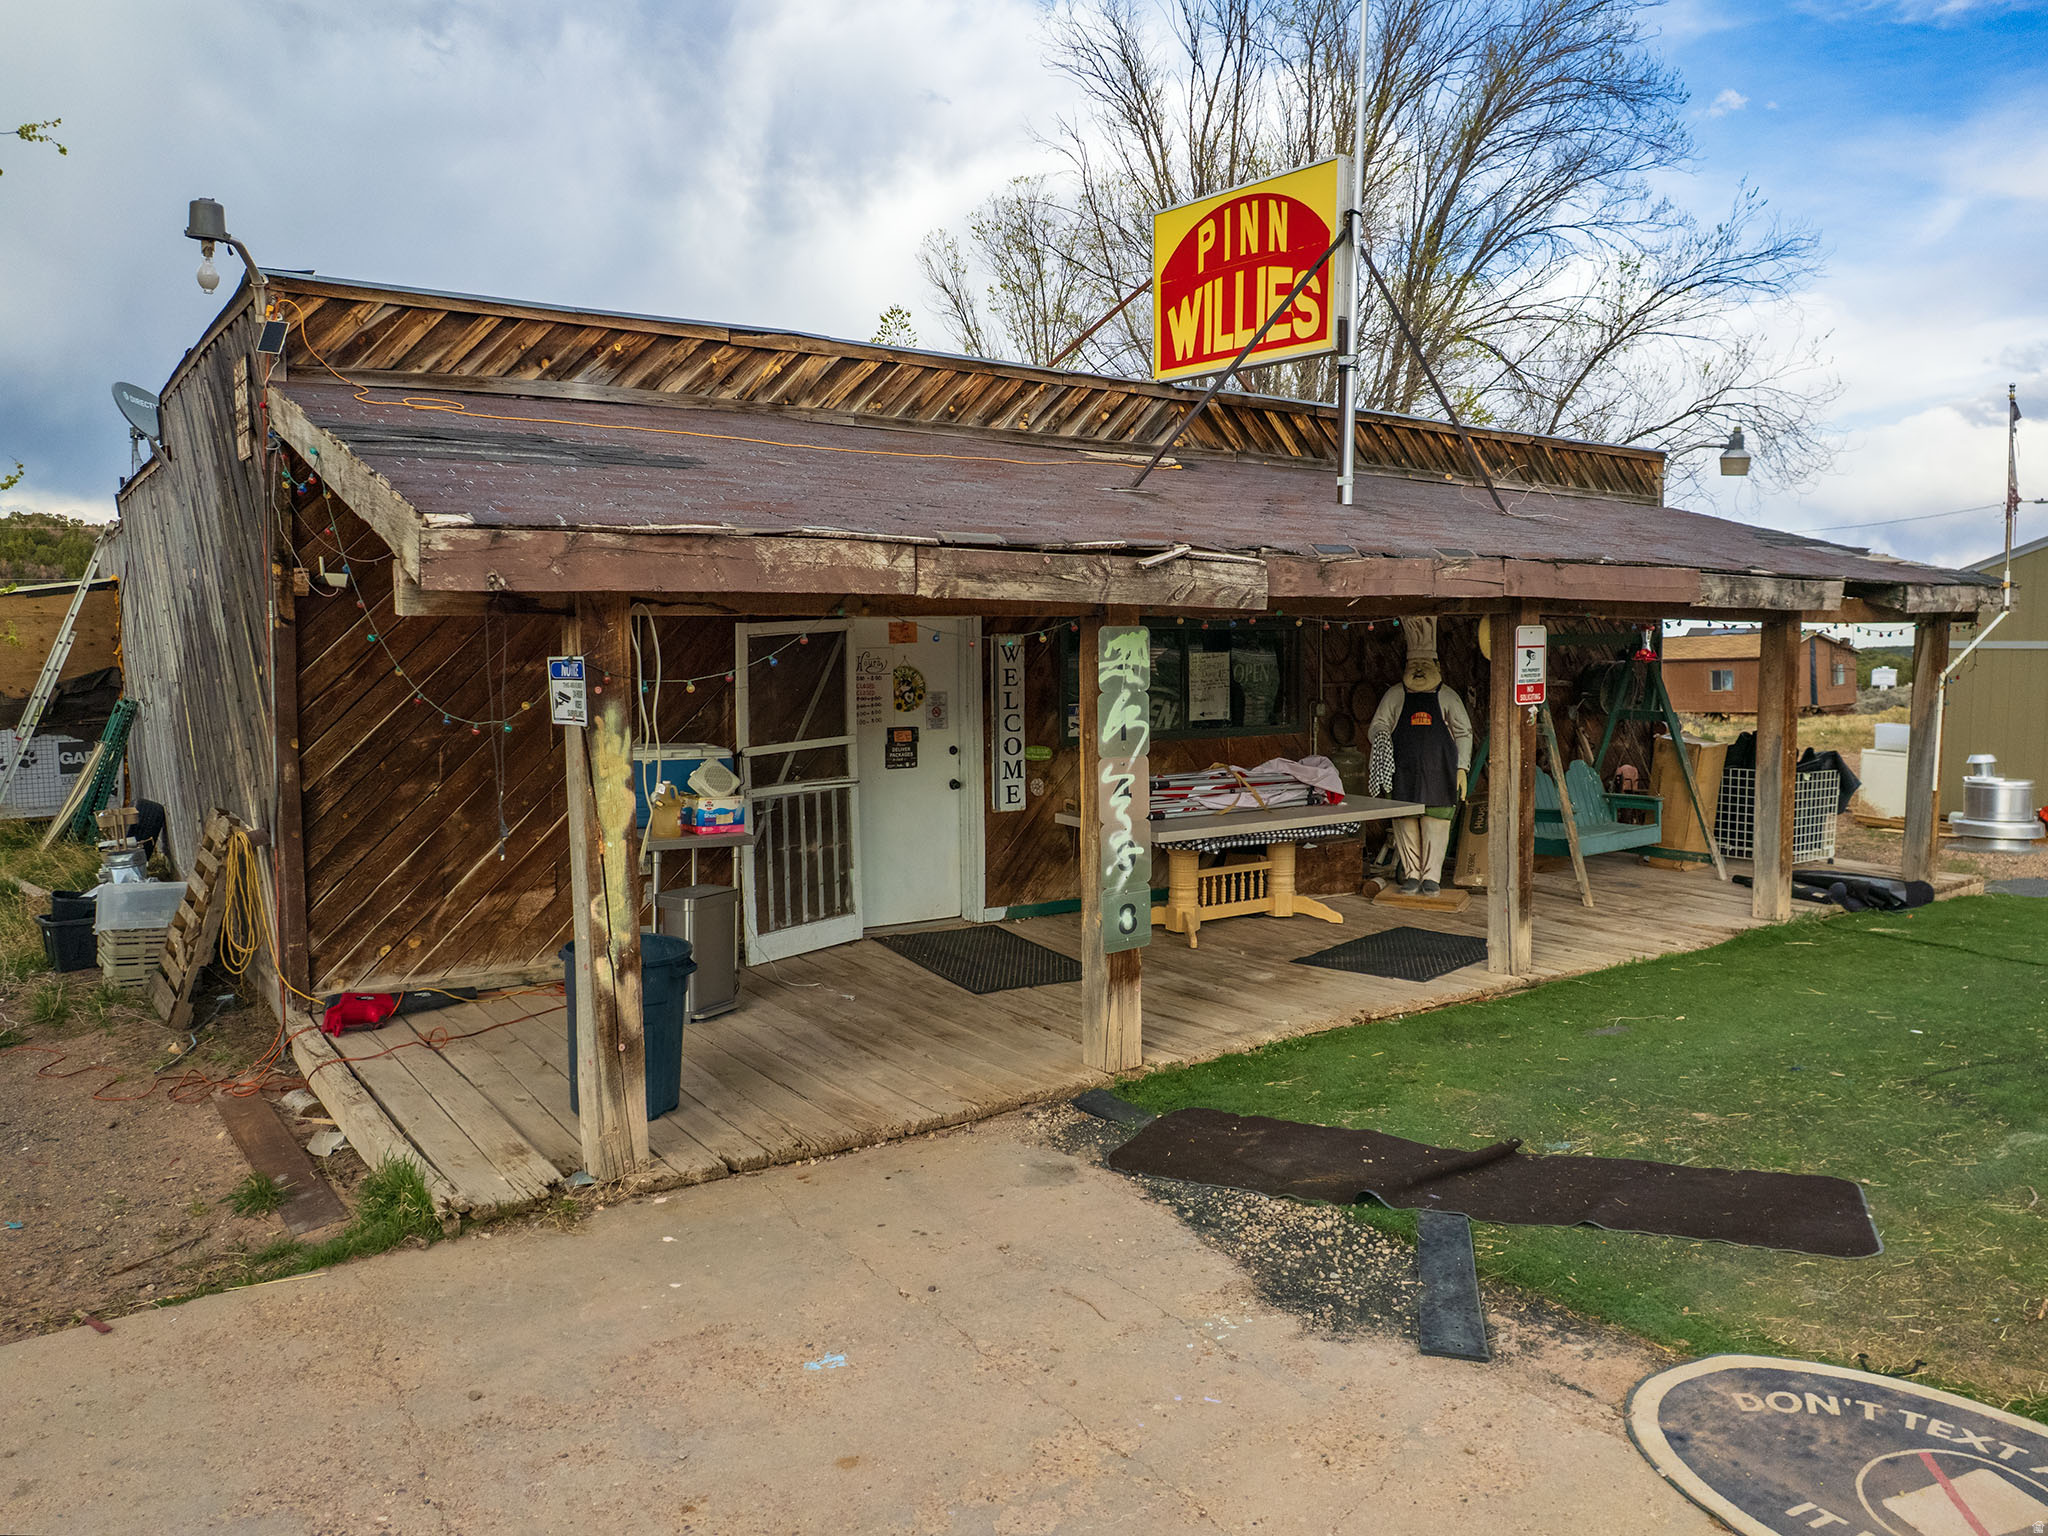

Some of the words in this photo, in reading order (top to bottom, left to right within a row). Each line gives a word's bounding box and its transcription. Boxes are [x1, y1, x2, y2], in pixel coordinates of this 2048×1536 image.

[1198, 199, 1288, 275] PINN
[1167, 266, 1321, 362] WILLIES
[1233, 663, 1270, 683] OPEN
[1520, 693, 1541, 701] SOLICITING
[1001, 644, 1024, 805] WELCOME
[1731, 1390, 1883, 1421] DON'T
[1898, 1408, 2029, 1460] TEXT
[1784, 1501, 1850, 1529] IT
